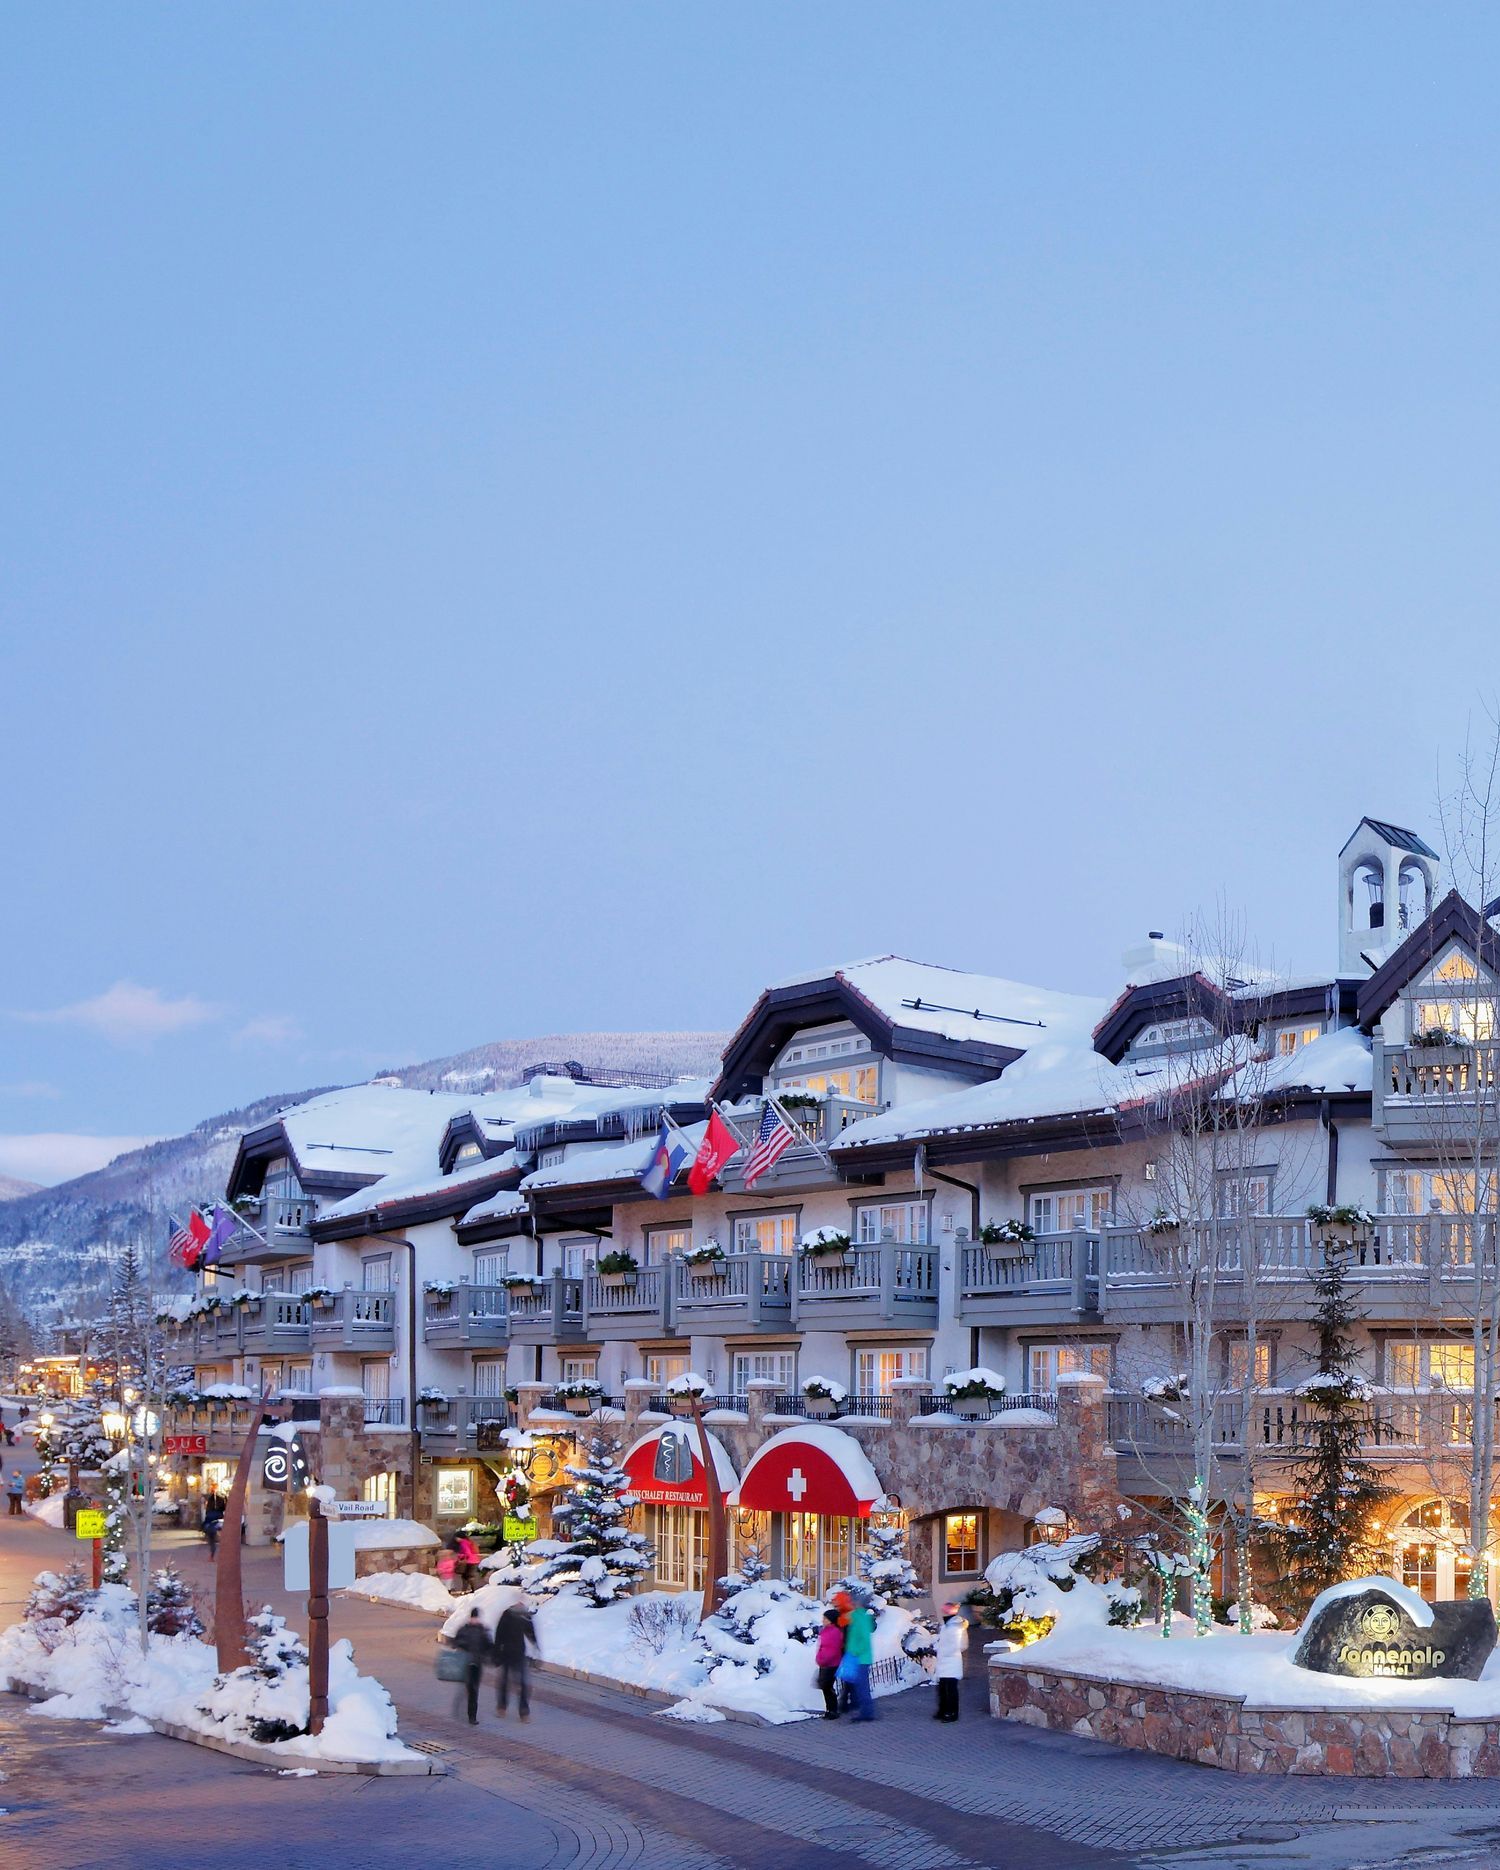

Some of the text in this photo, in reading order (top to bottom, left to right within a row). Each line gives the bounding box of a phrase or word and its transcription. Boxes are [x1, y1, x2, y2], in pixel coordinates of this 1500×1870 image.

[641, 1490, 665, 1501] CHALET
[665, 1491, 703, 1503] RESTAURANT
[338, 1503, 353, 1511] Vail
[354, 1503, 375, 1511] Road
[1337, 1645, 1446, 1668] Sonnenalp
[1373, 1664, 1408, 1676] Hotel
